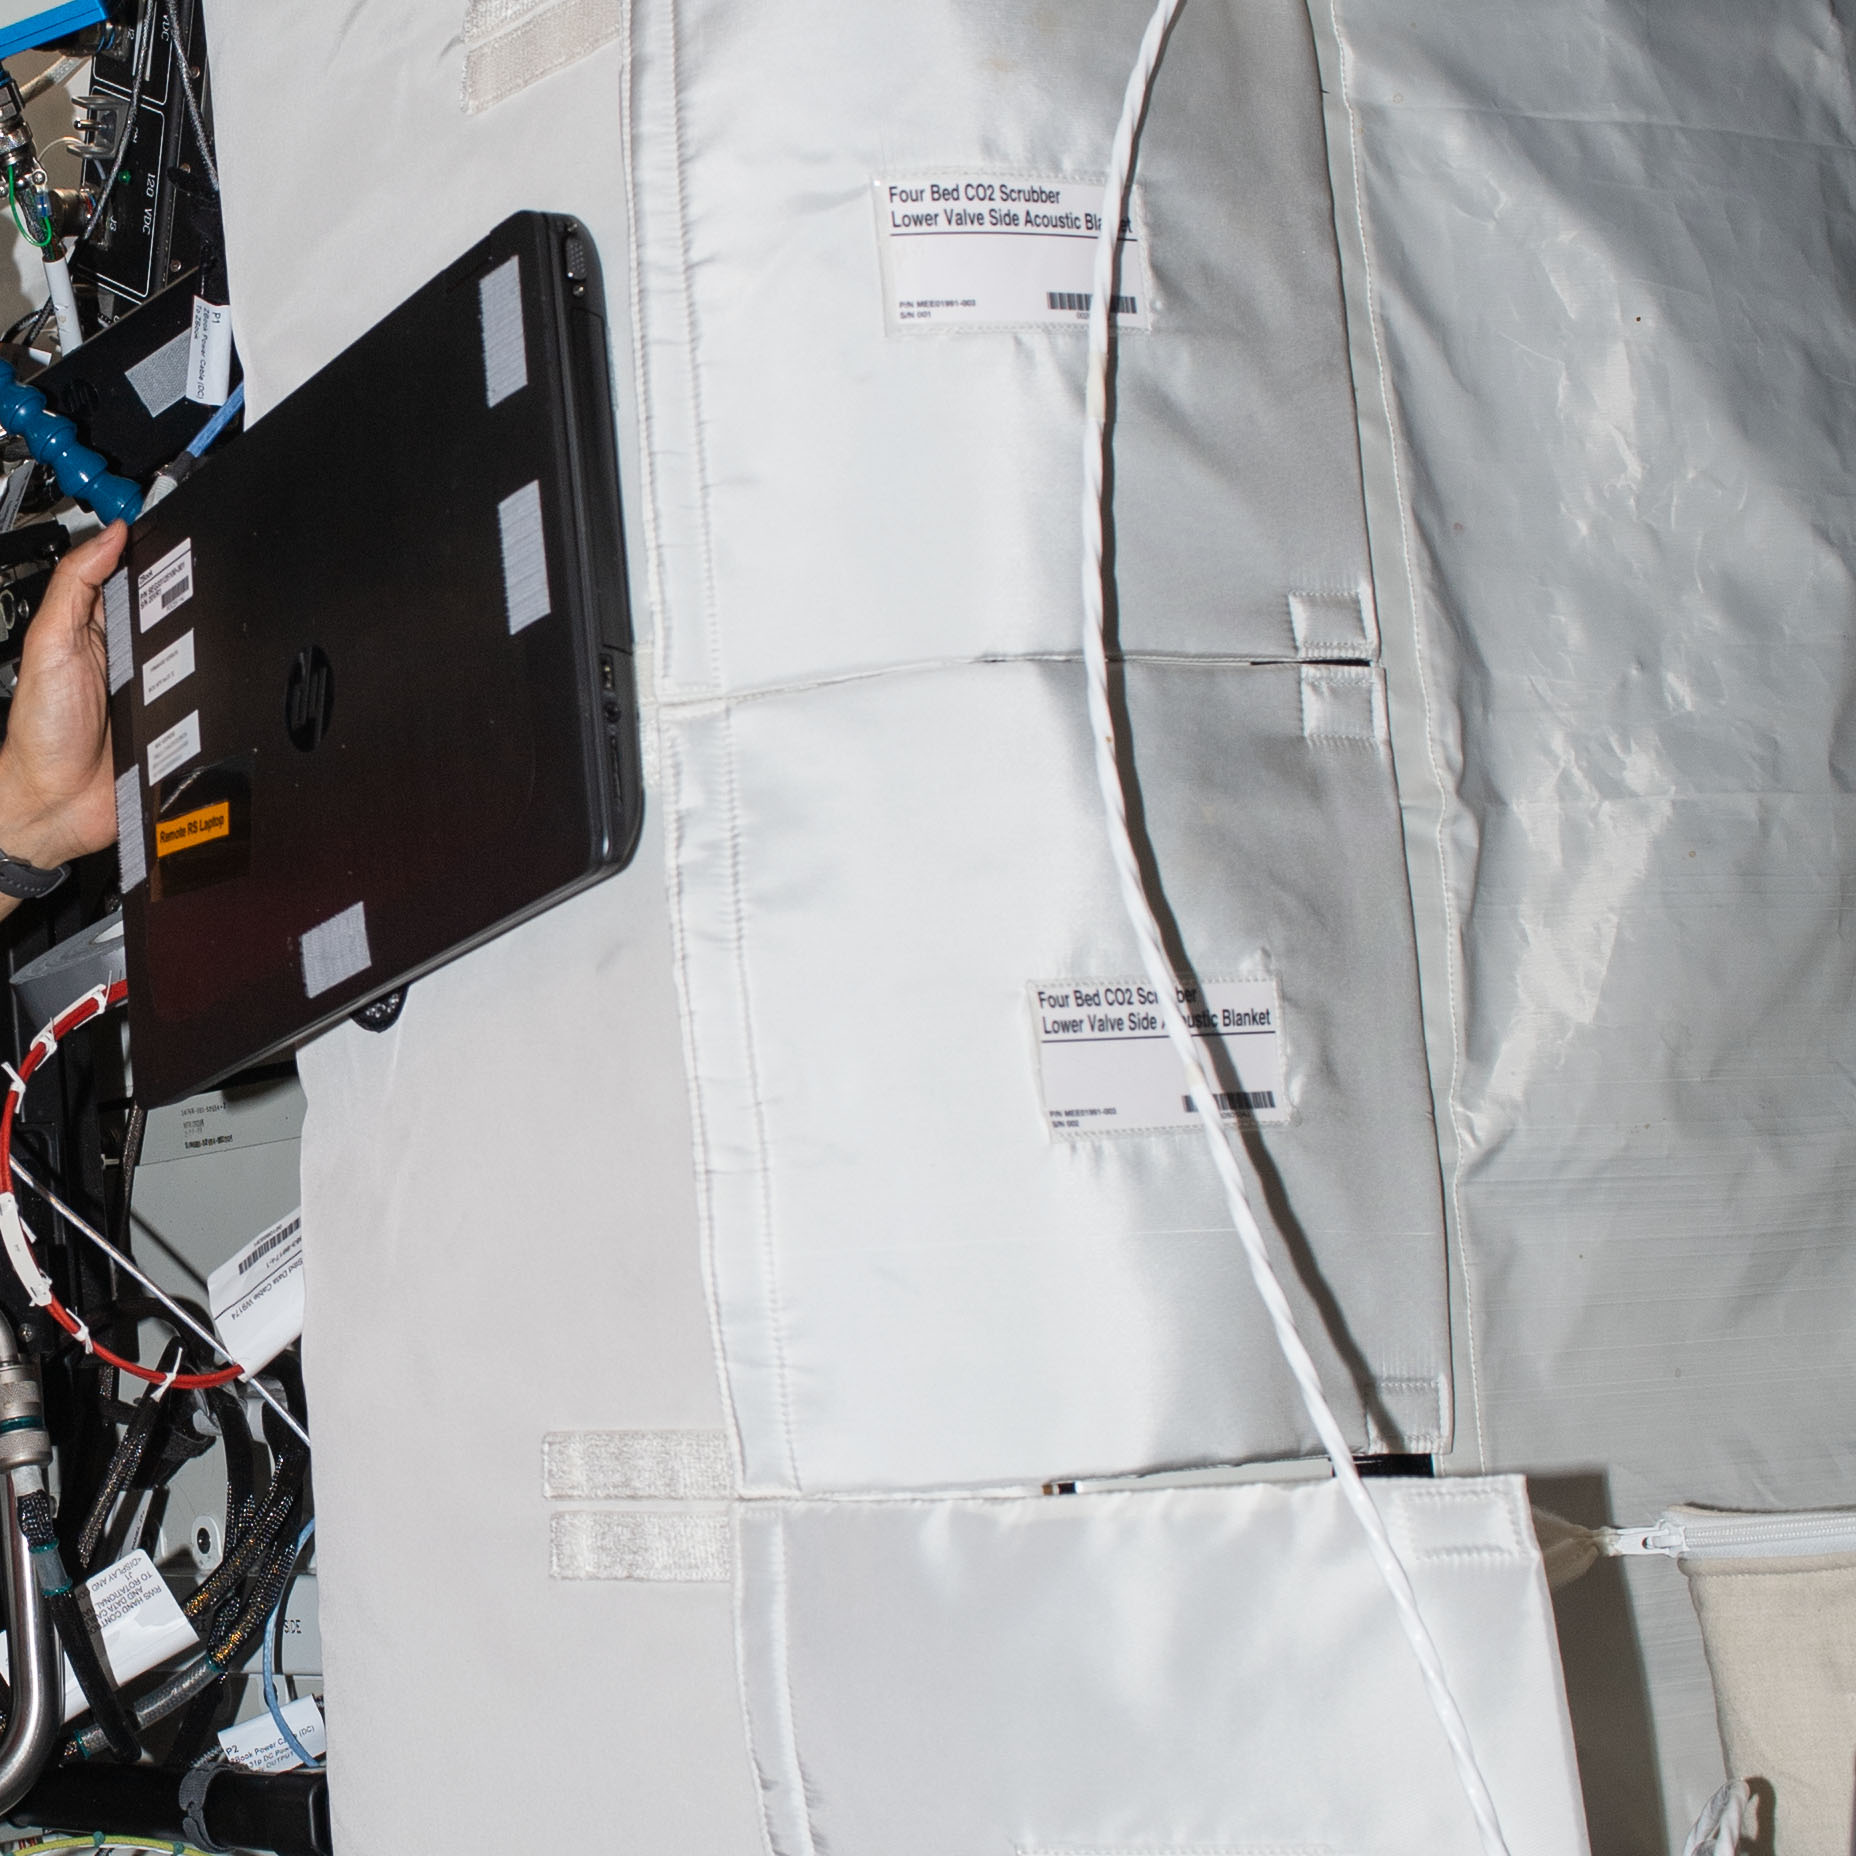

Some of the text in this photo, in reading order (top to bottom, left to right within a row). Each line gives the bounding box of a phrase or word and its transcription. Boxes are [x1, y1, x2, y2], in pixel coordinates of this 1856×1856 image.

[142, 172, 155, 234] 120 VDC
[889, 184, 1059, 205] Four Bed CO2 Scrubber
[891, 208, 1133, 233] Lower Valve Side Acoustic Blaet
[210, 311, 220, 324] P1
[159, 813, 224, 842] Remote RS Laptop
[1037, 985, 1197, 1007] Four Bed CO2 Scrber
[1042, 1015, 1083, 1034] Lower
[1086, 1015, 1124, 1032] Valve
[1126, 1013, 1156, 1030] Side
[1221, 1009, 1270, 1025] Blanket
[124, 1571, 134, 1581] J1
[225, 1744, 238, 1755] P2
